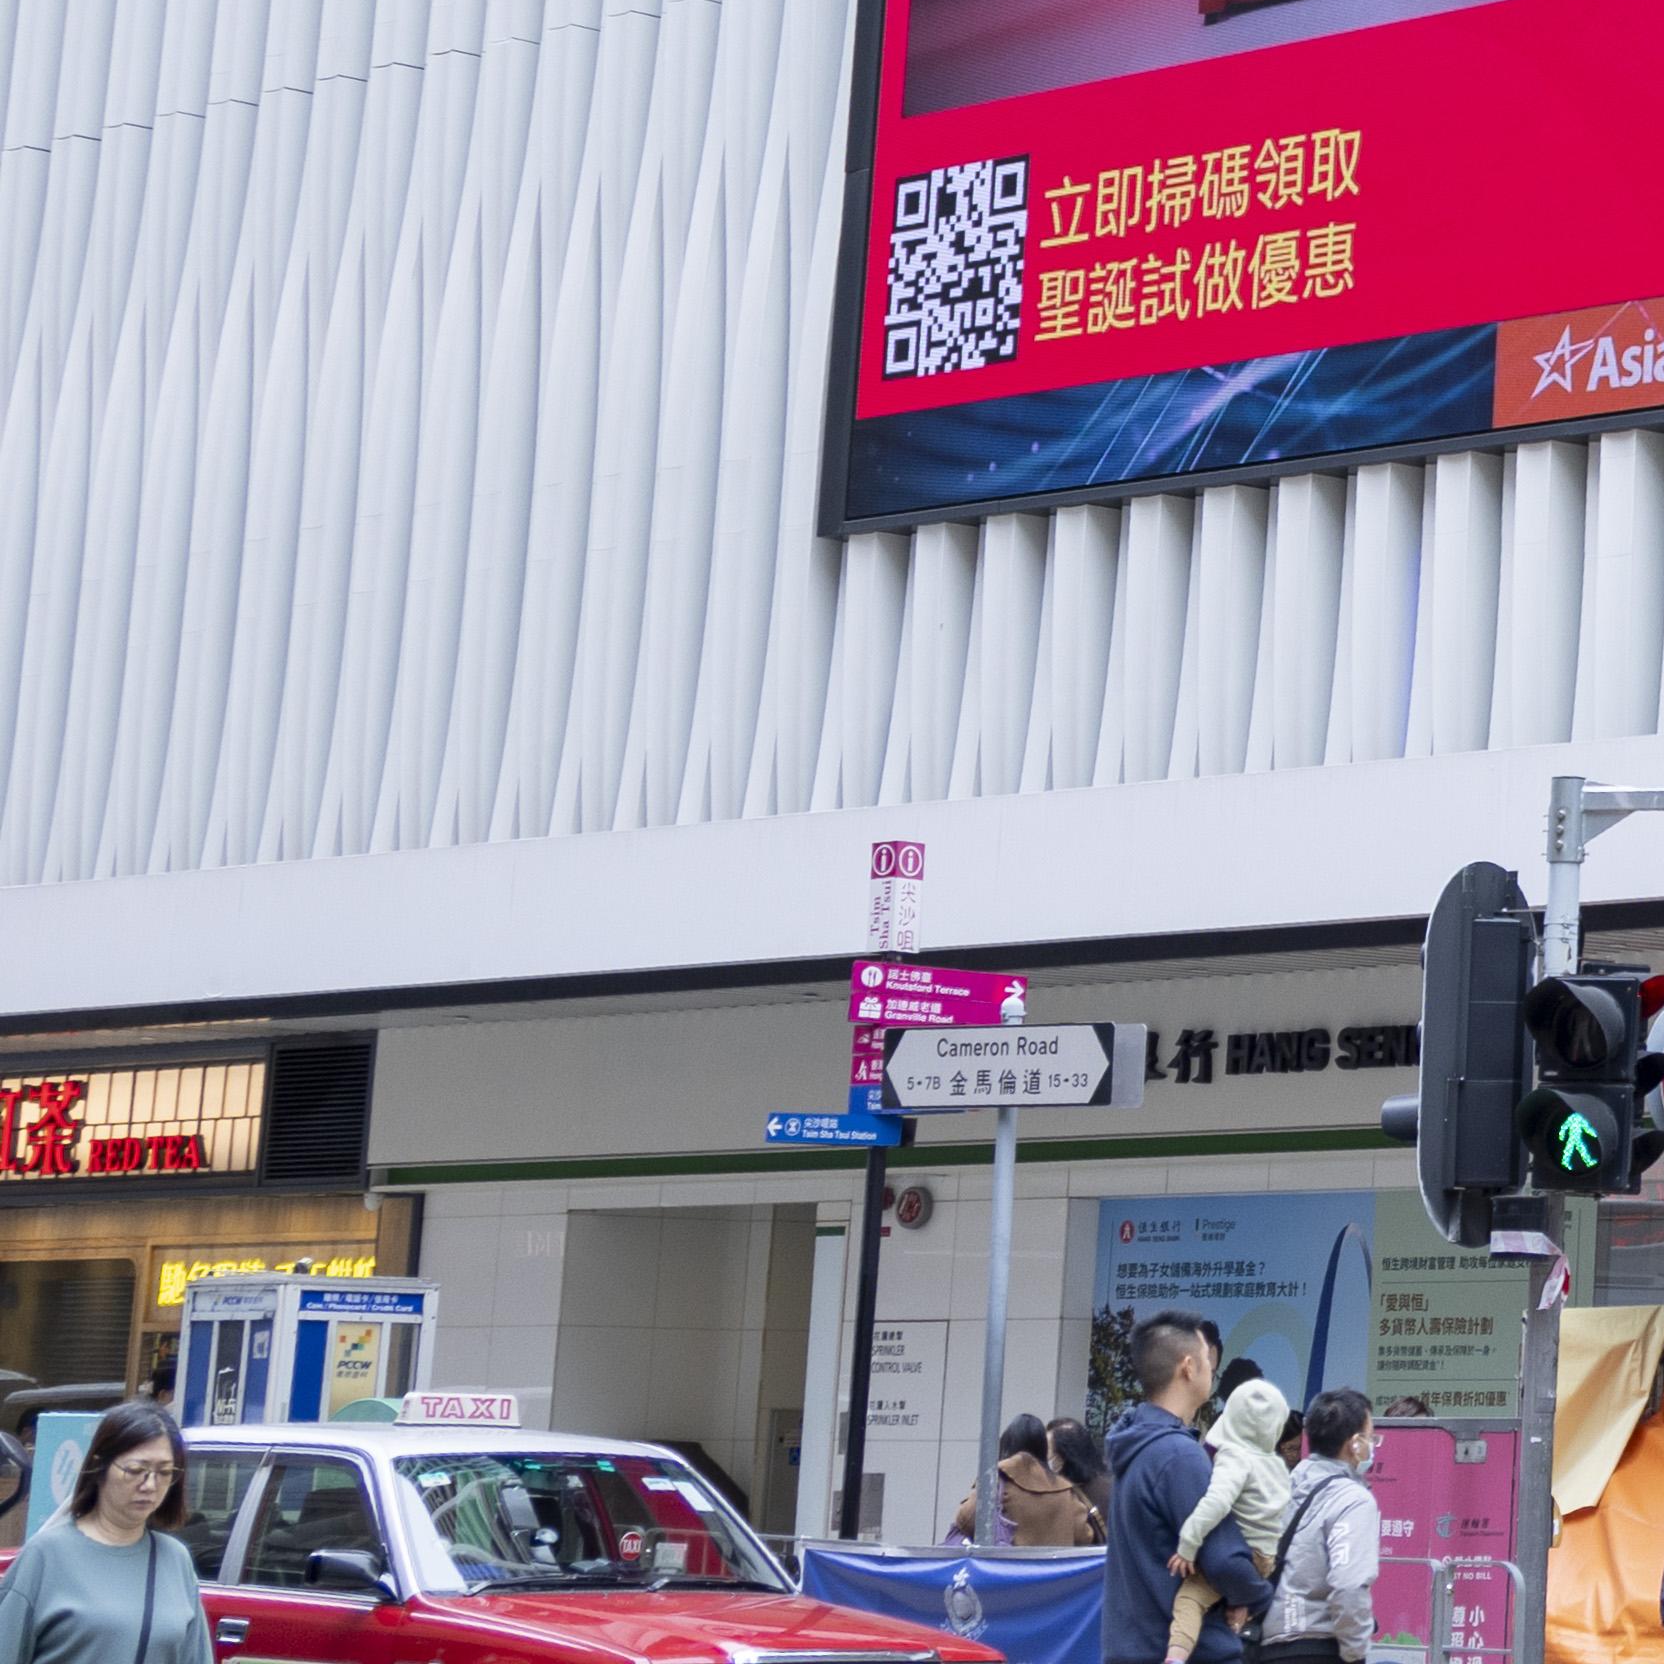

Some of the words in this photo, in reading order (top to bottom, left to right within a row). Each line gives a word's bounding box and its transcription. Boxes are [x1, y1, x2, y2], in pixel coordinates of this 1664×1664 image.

[1040, 126, 1362, 249] 立即掃碼領取
[1034, 222, 1357, 342] 聖誕試做優惠
[881, 880, 892, 915] Tsui
[870, 896, 881, 937] Tsim
[897, 882, 916, 951] 尖沙咀
[880, 921, 889, 949] Sha
[935, 984, 971, 997] Terrace
[884, 1010, 927, 1022] Granville
[928, 1013, 954, 1024] Road
[936, 1036, 1010, 1058] Cameron
[1016, 1036, 1059, 1056] Road
[1225, 1028, 1332, 1075] HANG
[1335, 1025, 1420, 1069] SEN
[949, 1068, 1041, 1097] 金馬倫道
[820, 1129, 833, 1139] Sha
[851, 1131, 877, 1140] Station
[88, 1137, 143, 1174] RED
[145, 1135, 201, 1170] TEA
[372, 1304, 394, 1312] Credit
[336, 1360, 372, 1371] PCCW
[421, 1397, 512, 1420] TAXI
